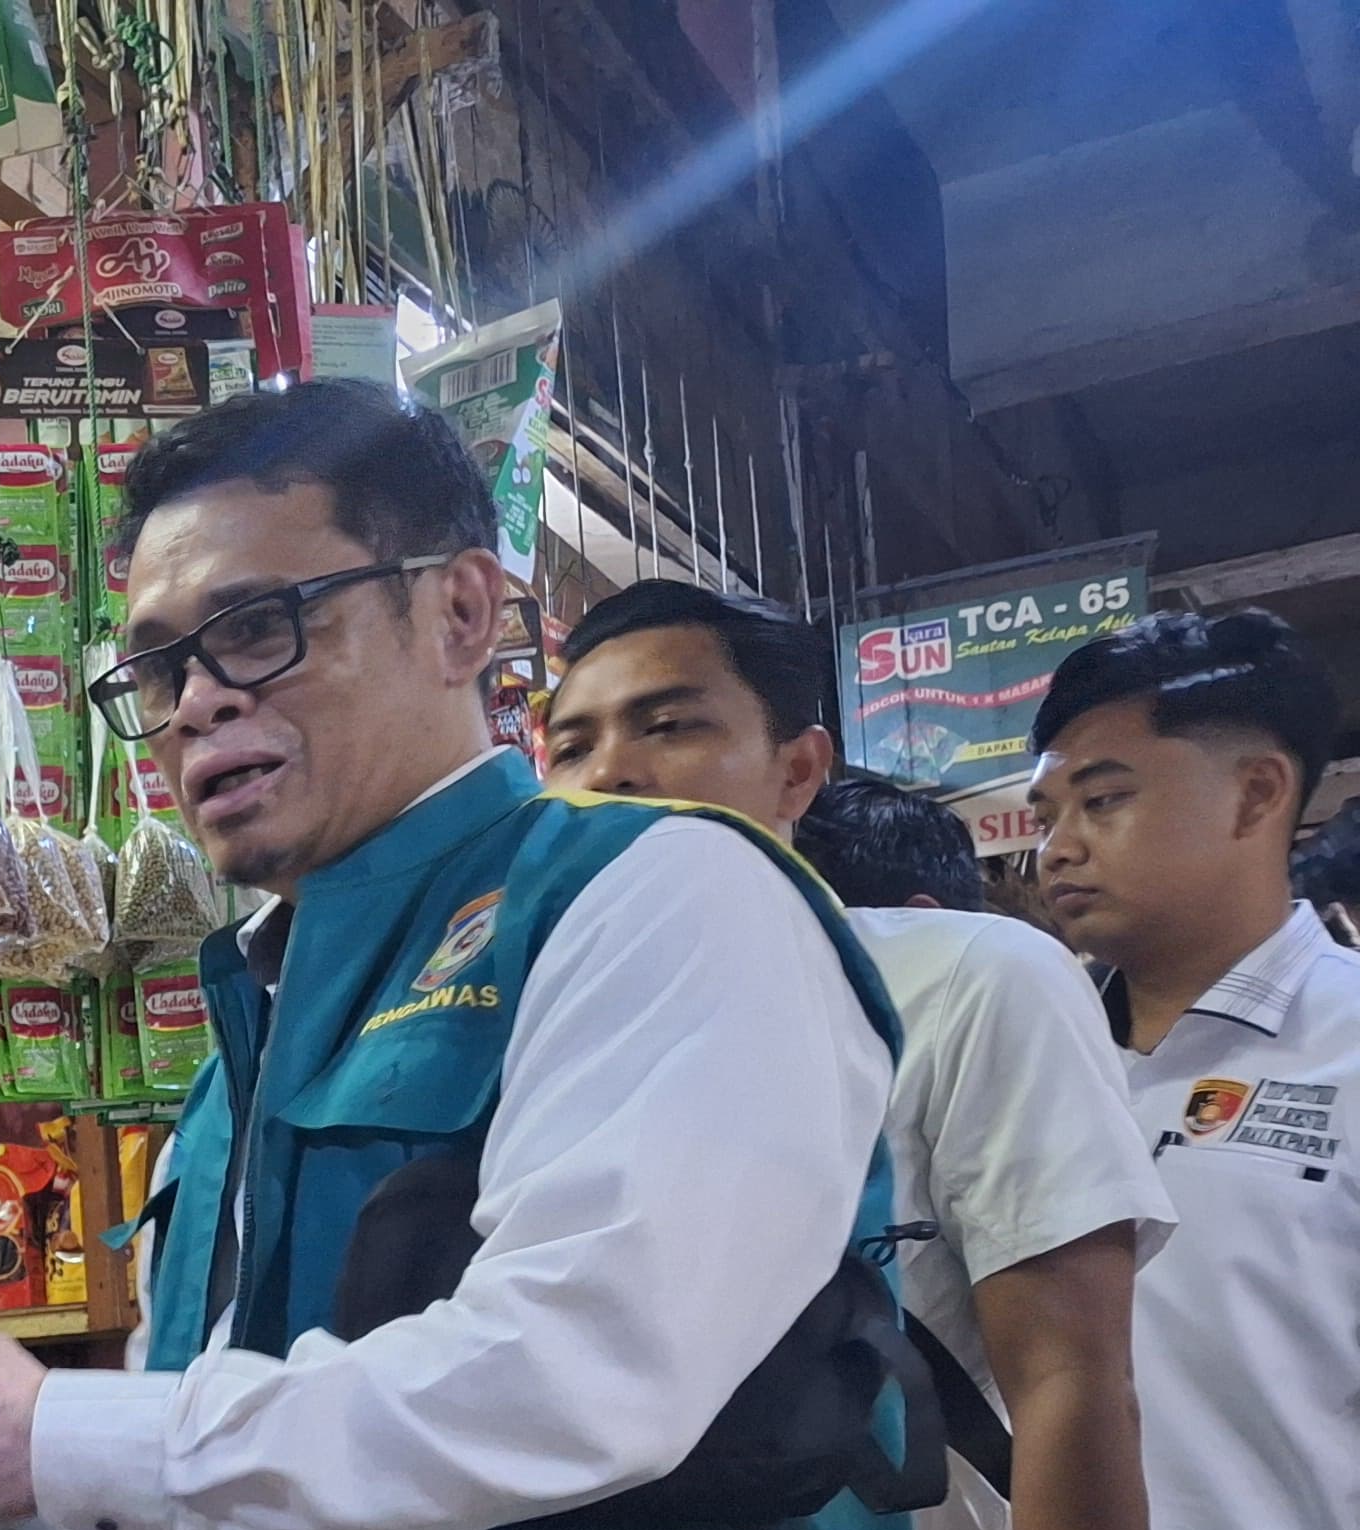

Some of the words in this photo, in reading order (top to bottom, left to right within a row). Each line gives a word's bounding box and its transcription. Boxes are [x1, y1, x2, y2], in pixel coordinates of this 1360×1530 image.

[22, 377, 76, 389] TEPUNG
[79, 377, 126, 389] BMBU
[2, 388, 142, 405] BERVITAMIN
[958, 595, 1044, 638] TCA
[1079, 577, 1130, 615] 65
[903, 624, 945, 644] kara
[955, 636, 1018, 659] Santan
[1025, 622, 1088, 644] Kelapa
[855, 626, 953, 686] SUN
[914, 687, 967, 706] UNTUK
[976, 740, 1015, 755] DAPAT
[13, 1002, 60, 1022] Ladaku
[359, 982, 501, 1037] PENGAWAS
